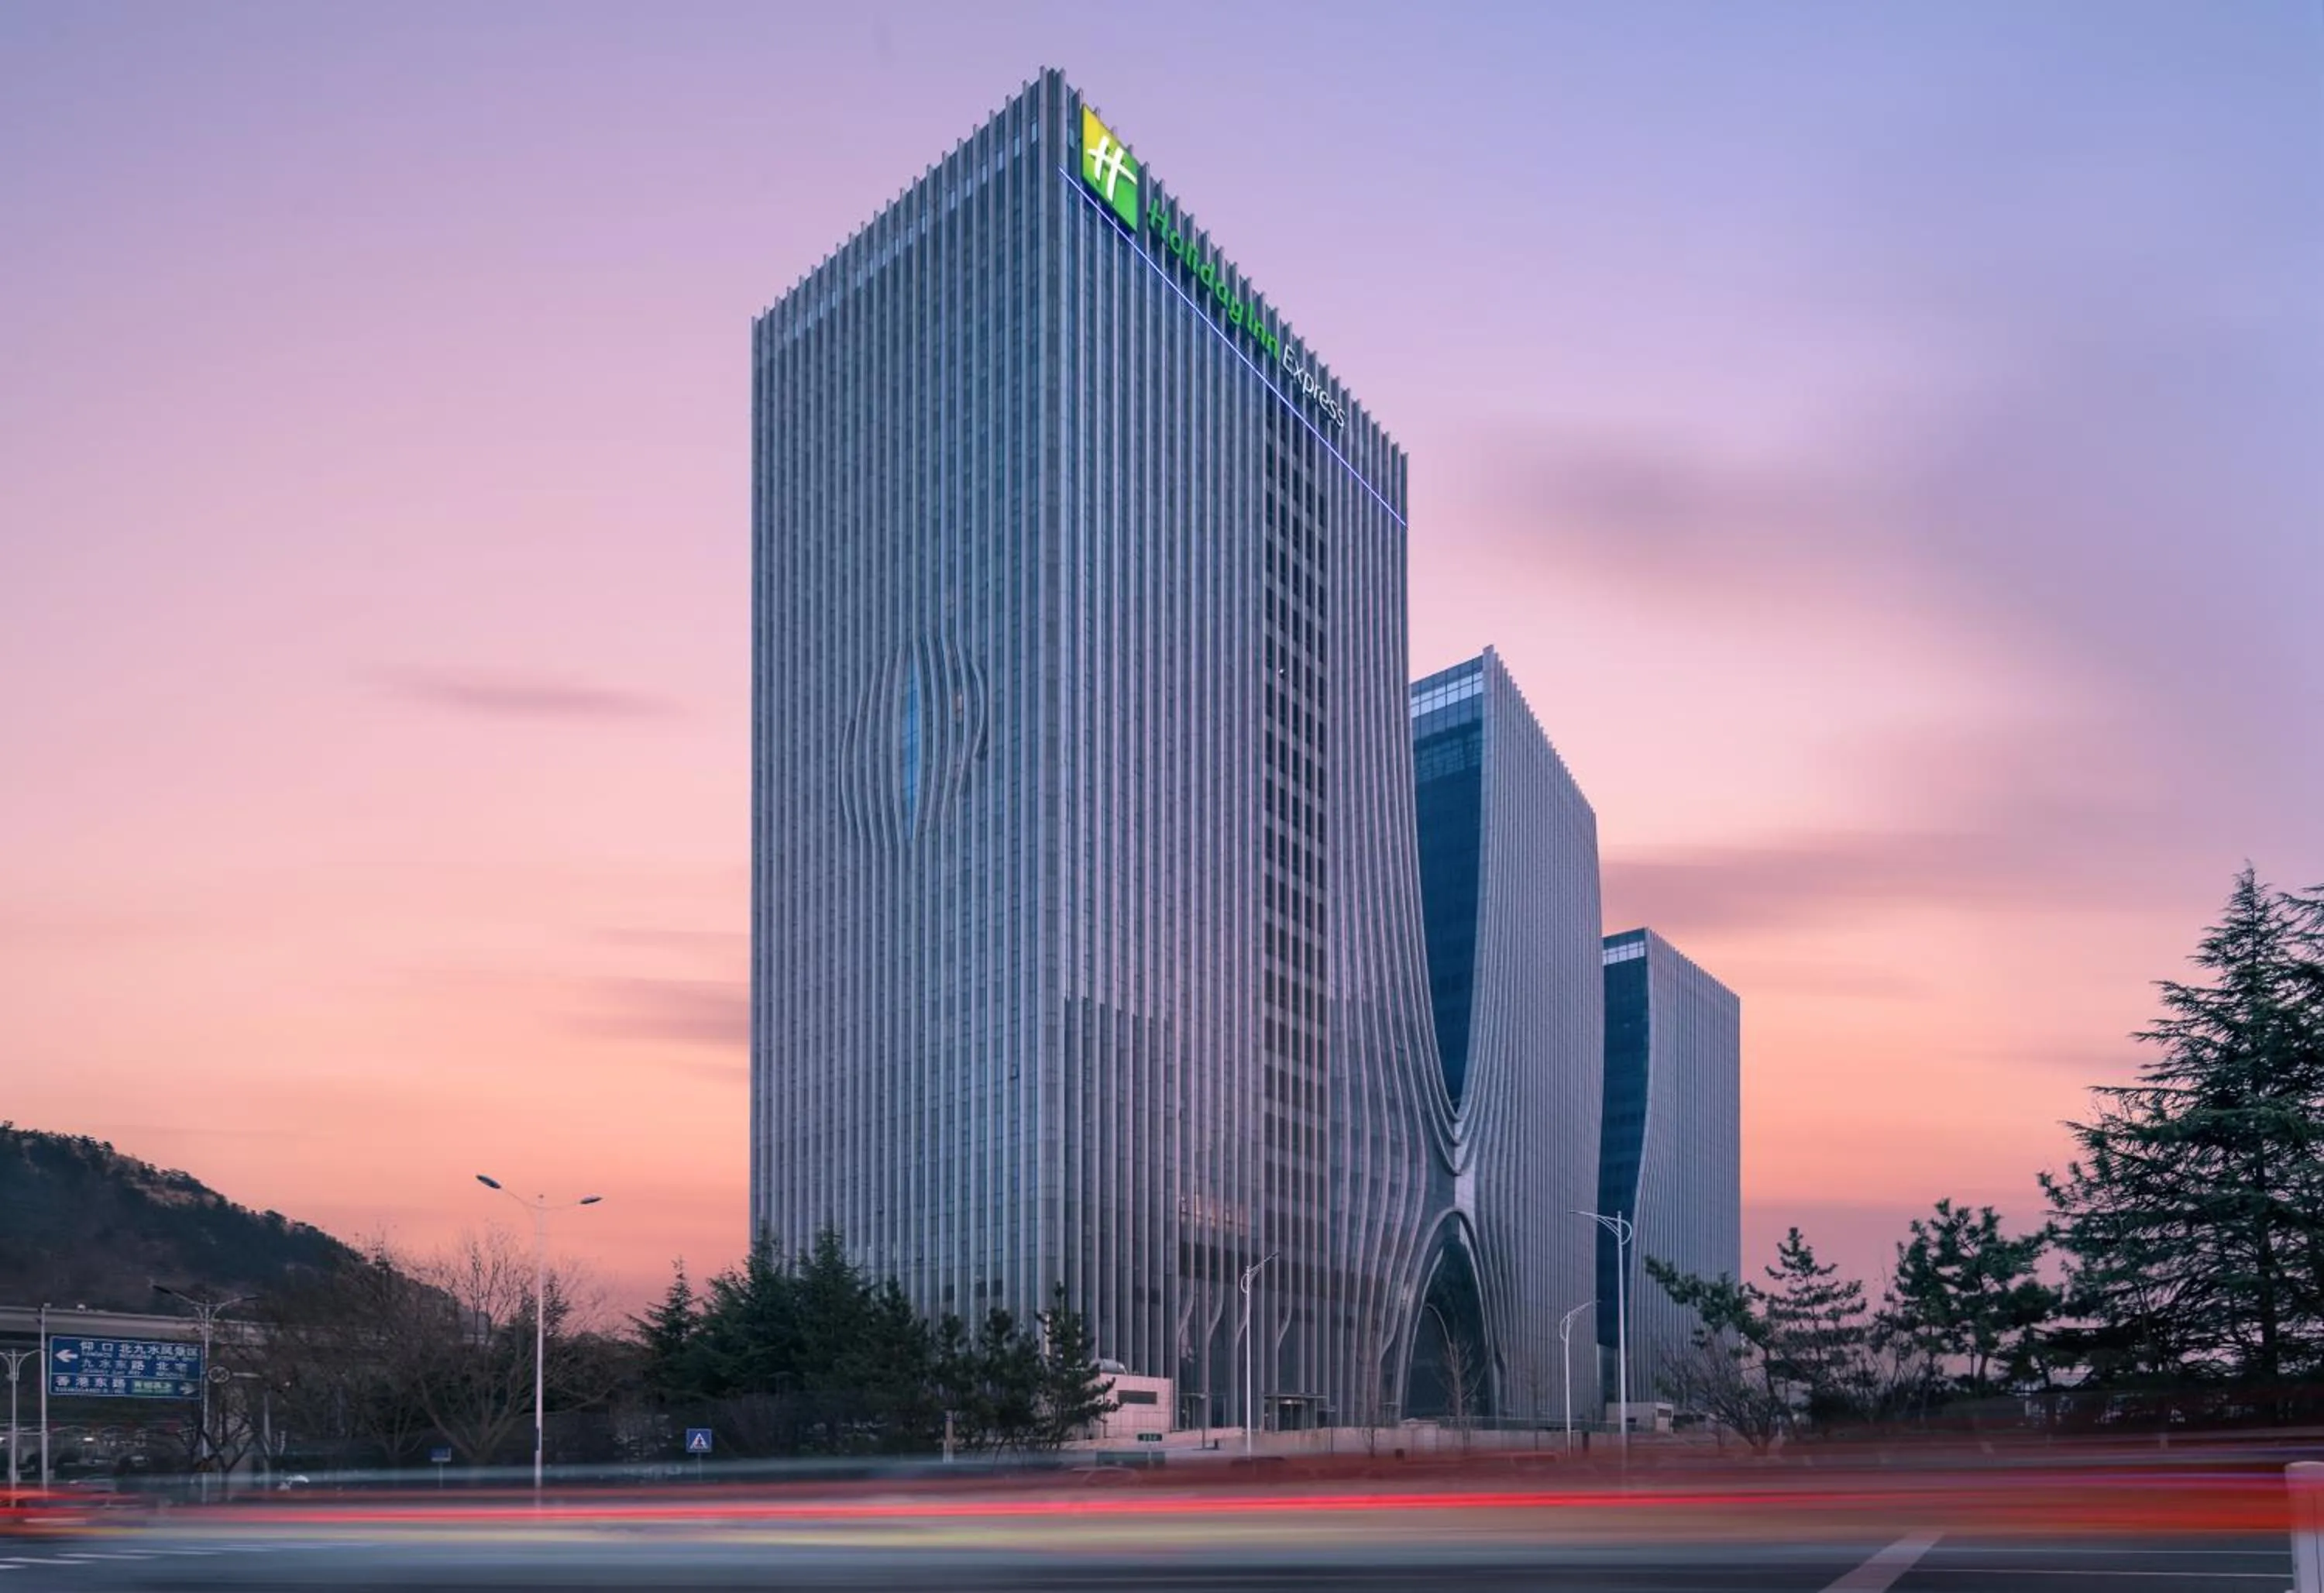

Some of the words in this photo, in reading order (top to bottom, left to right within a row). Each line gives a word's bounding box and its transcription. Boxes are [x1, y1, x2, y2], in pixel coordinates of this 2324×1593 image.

[1147, 197, 1243, 323] Holiday
[1247, 303, 1279, 359] Inn
[1282, 343, 1346, 428] Express
[119, 1343, 199, 1356] 北九水风景区
